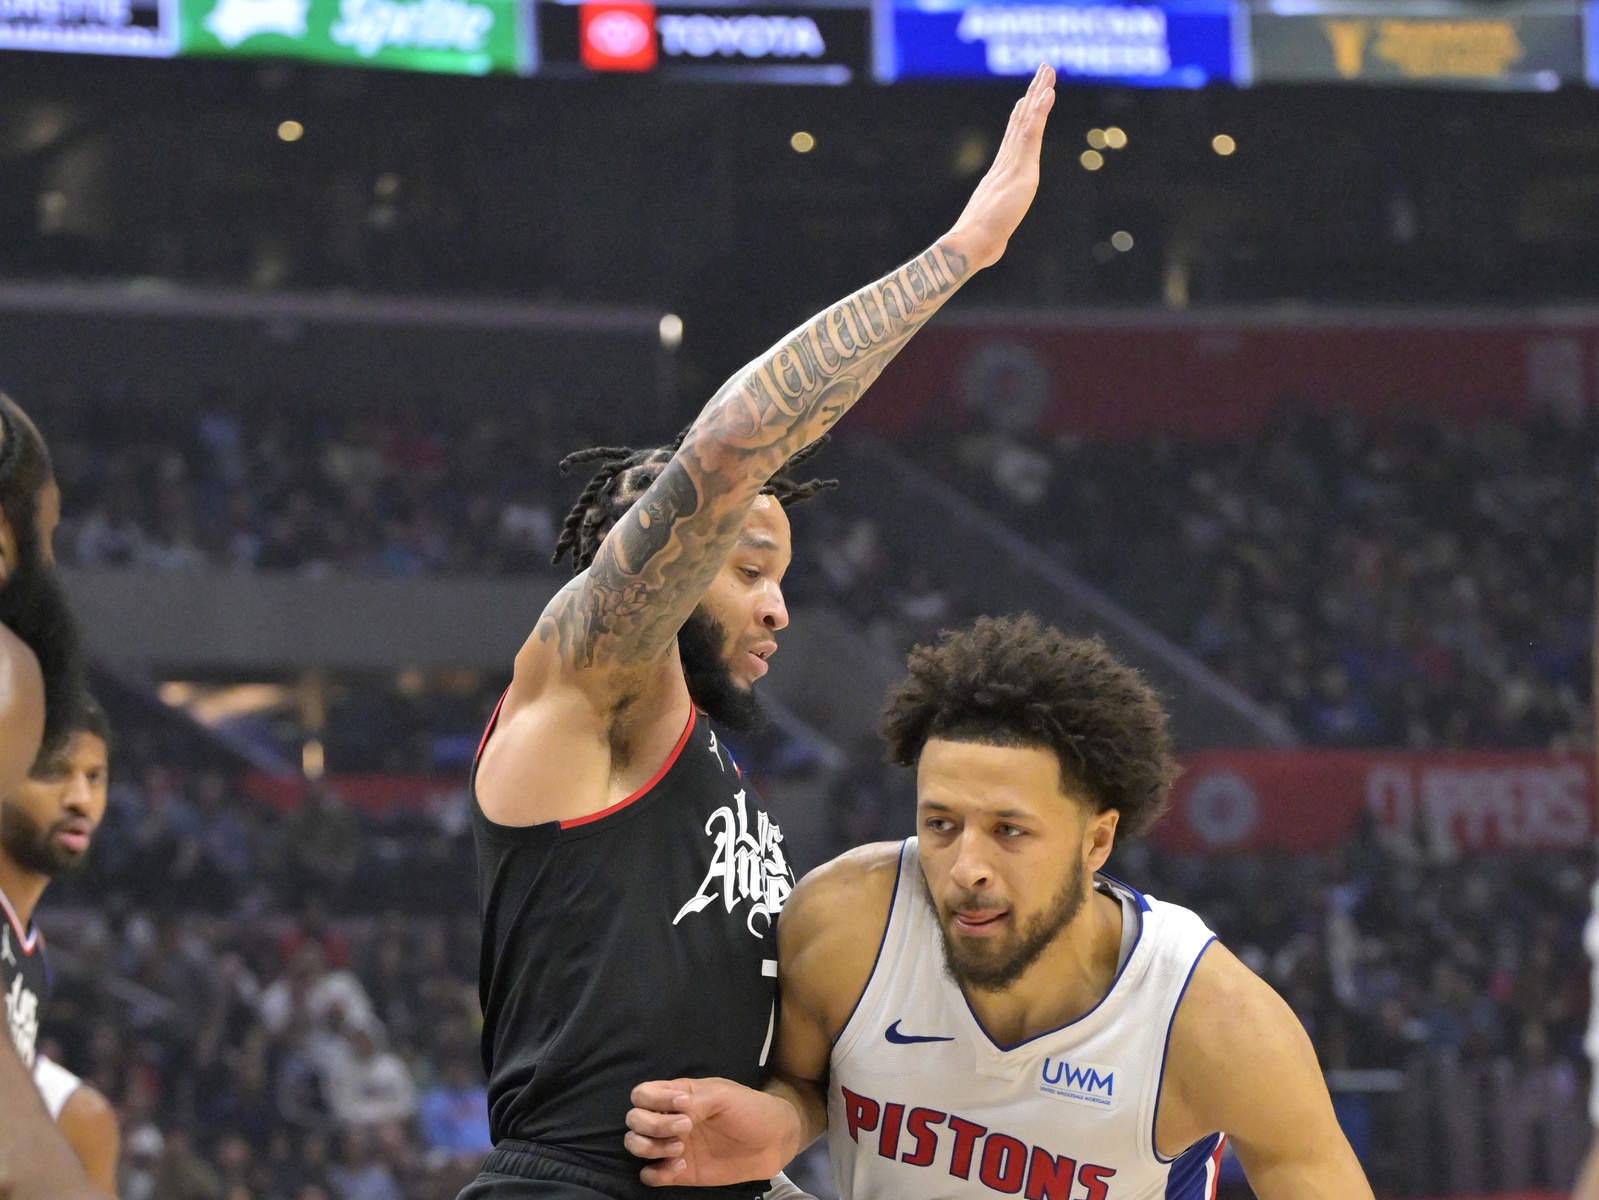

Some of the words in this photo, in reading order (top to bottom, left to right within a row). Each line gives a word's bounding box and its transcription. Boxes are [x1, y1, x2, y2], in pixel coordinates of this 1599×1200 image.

[656, 15, 824, 57] TOYOTA
[957, 5, 1167, 43] AMERICAN
[985, 44, 1171, 76] EXPRESS
[1042, 1057, 1114, 1097] UWM
